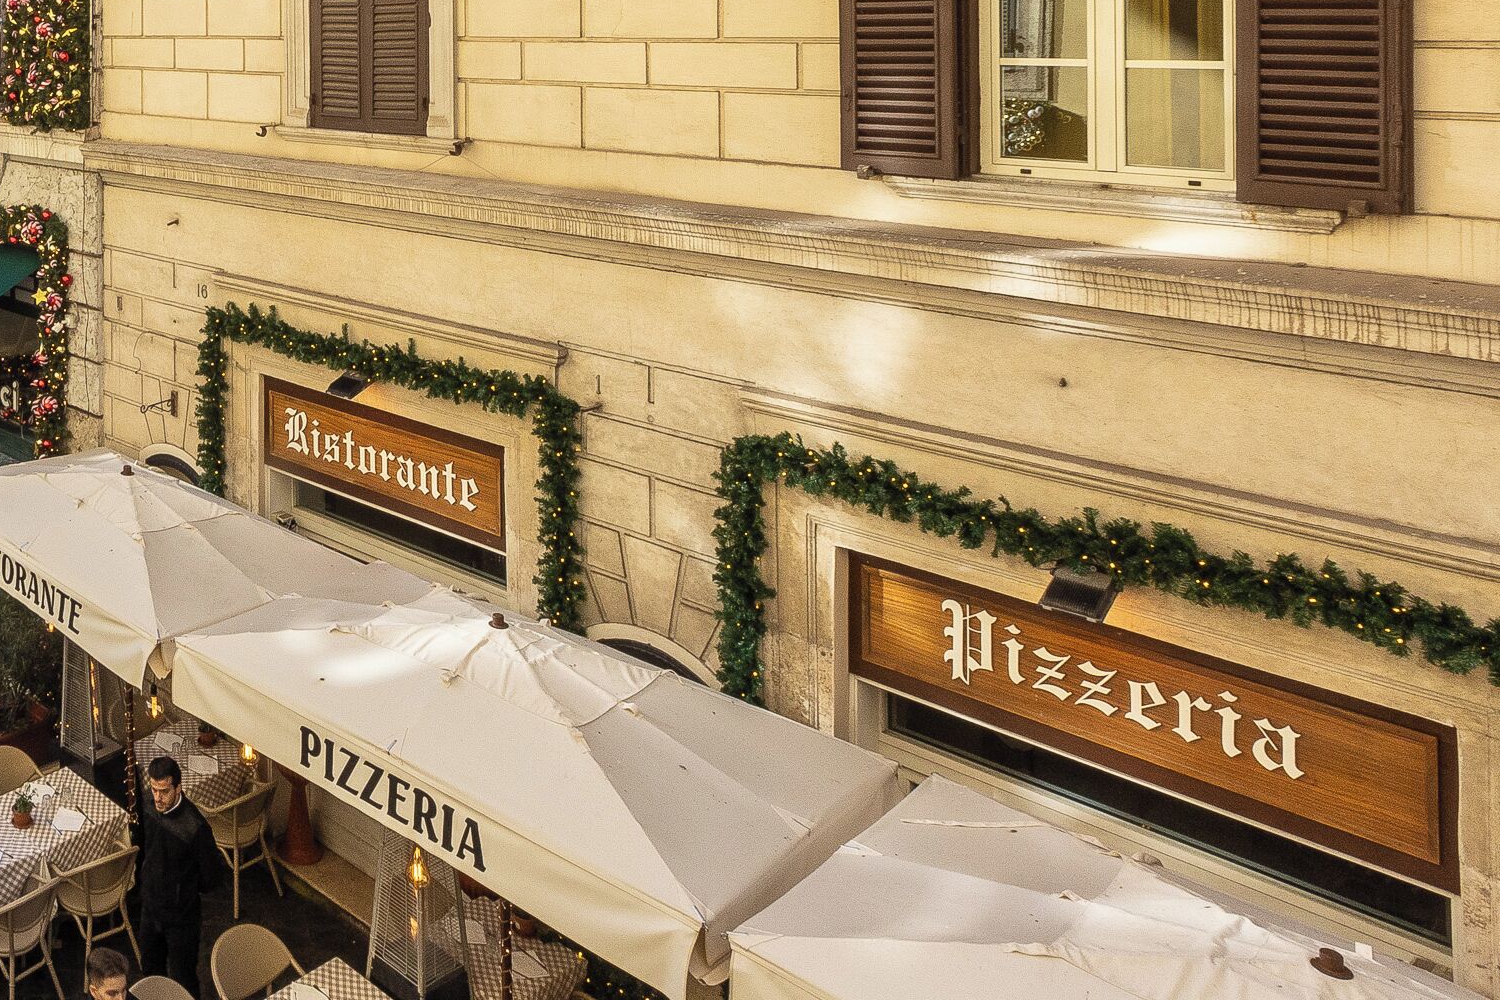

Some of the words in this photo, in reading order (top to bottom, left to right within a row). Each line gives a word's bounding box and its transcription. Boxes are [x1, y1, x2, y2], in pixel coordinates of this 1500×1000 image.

[196, 283, 208, 299] 16
[285, 407, 480, 512] Ristorante
[941, 599, 1305, 780] Pizzeria
[300, 725, 487, 873] PIZZERIA
